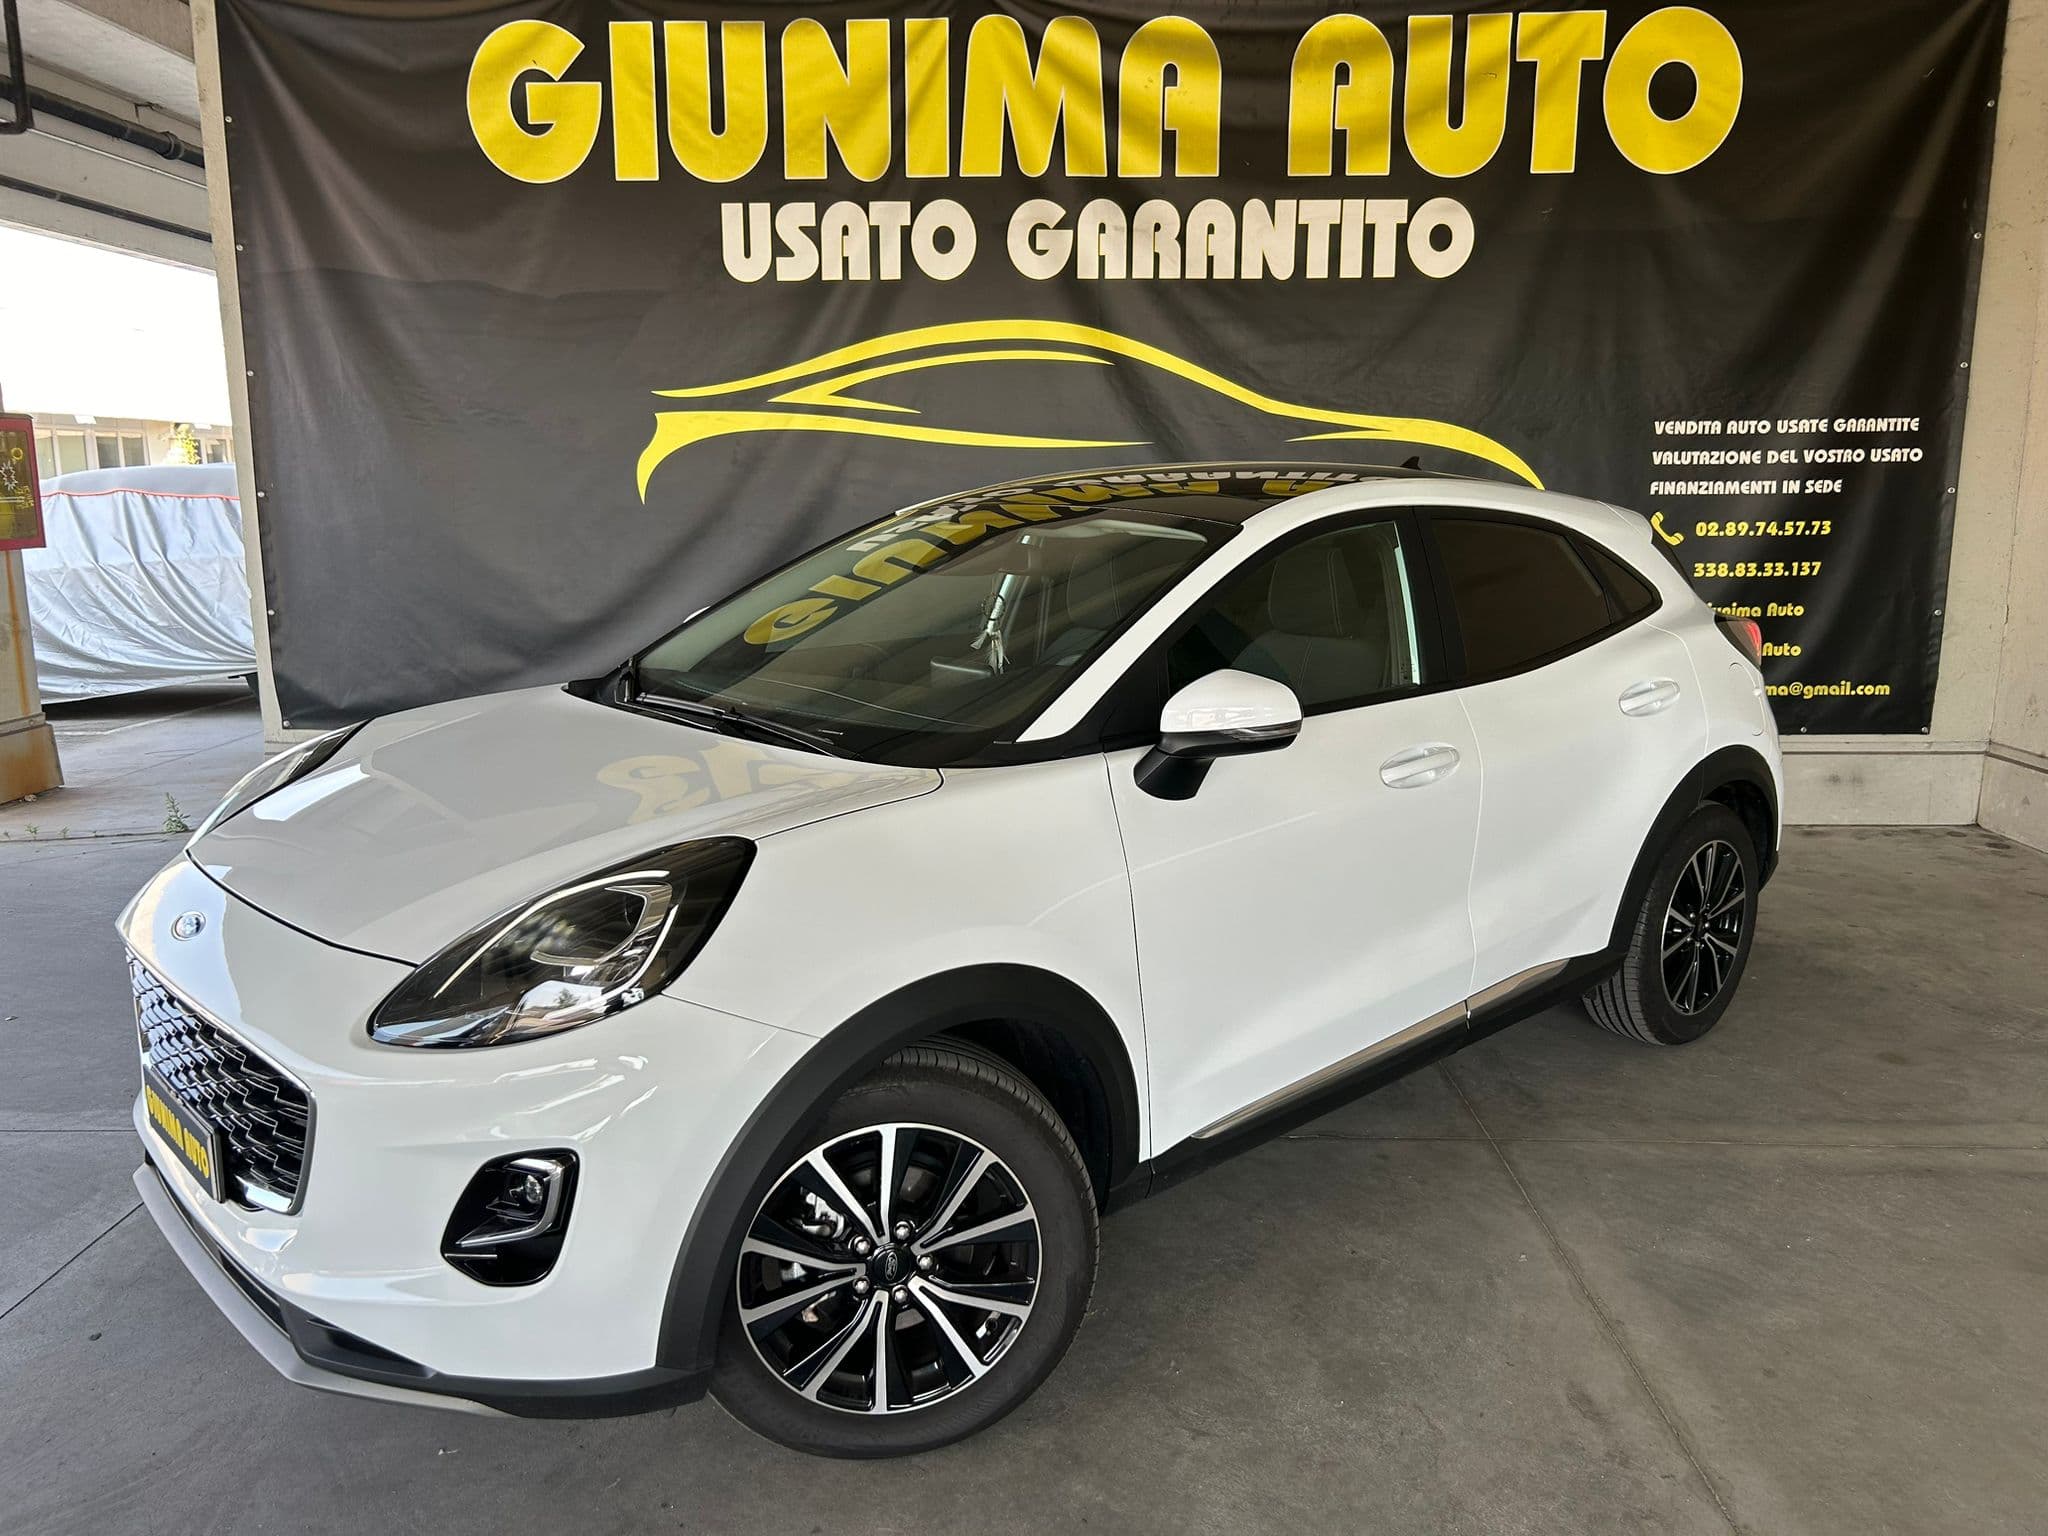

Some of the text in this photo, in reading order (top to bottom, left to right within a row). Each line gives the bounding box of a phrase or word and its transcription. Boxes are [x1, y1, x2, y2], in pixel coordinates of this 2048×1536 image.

[466, 6, 1743, 184] GIUNIMA AUTO
[720, 197, 1475, 283] USATO GARANTITO
[1654, 418, 1920, 434] VENDITA AUTO USATE GARANTITE
[1652, 448, 1924, 465] VALUTAZIONE DEL VOSTRO USATO
[1649, 480, 1843, 495] FINANZIAMENTI IN SEDE
[1695, 521, 1832, 536] 02.89.74.57.73
[1693, 562, 1822, 577] 338.83.33.137
[1766, 603, 1805, 616] Auto
[1762, 643, 1802, 656] Auto
